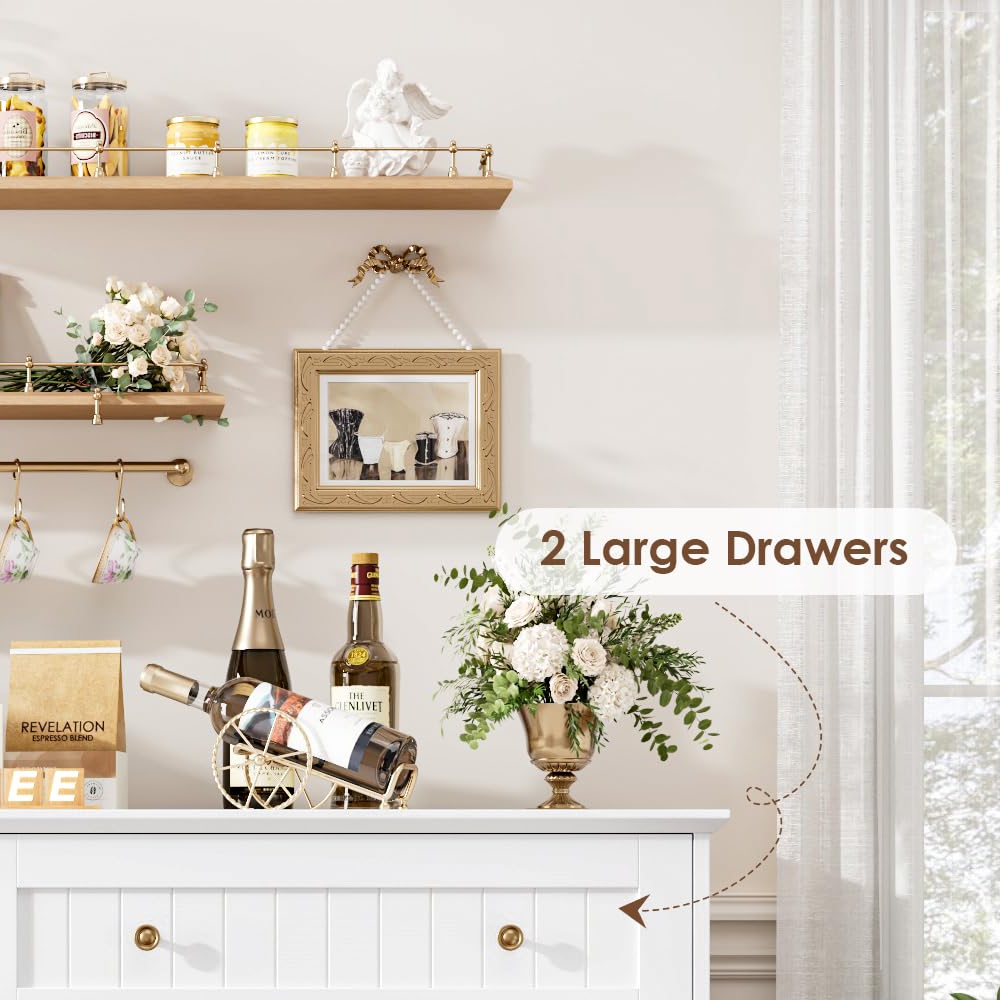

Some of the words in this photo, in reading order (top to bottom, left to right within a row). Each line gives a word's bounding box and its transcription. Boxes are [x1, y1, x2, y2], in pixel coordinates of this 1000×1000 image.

[349, 692, 364, 700] THE
[21, 720, 105, 734] REVELATION
[32, 734, 68, 742] ESPRESSO
[69, 734, 94, 742] BLEND
